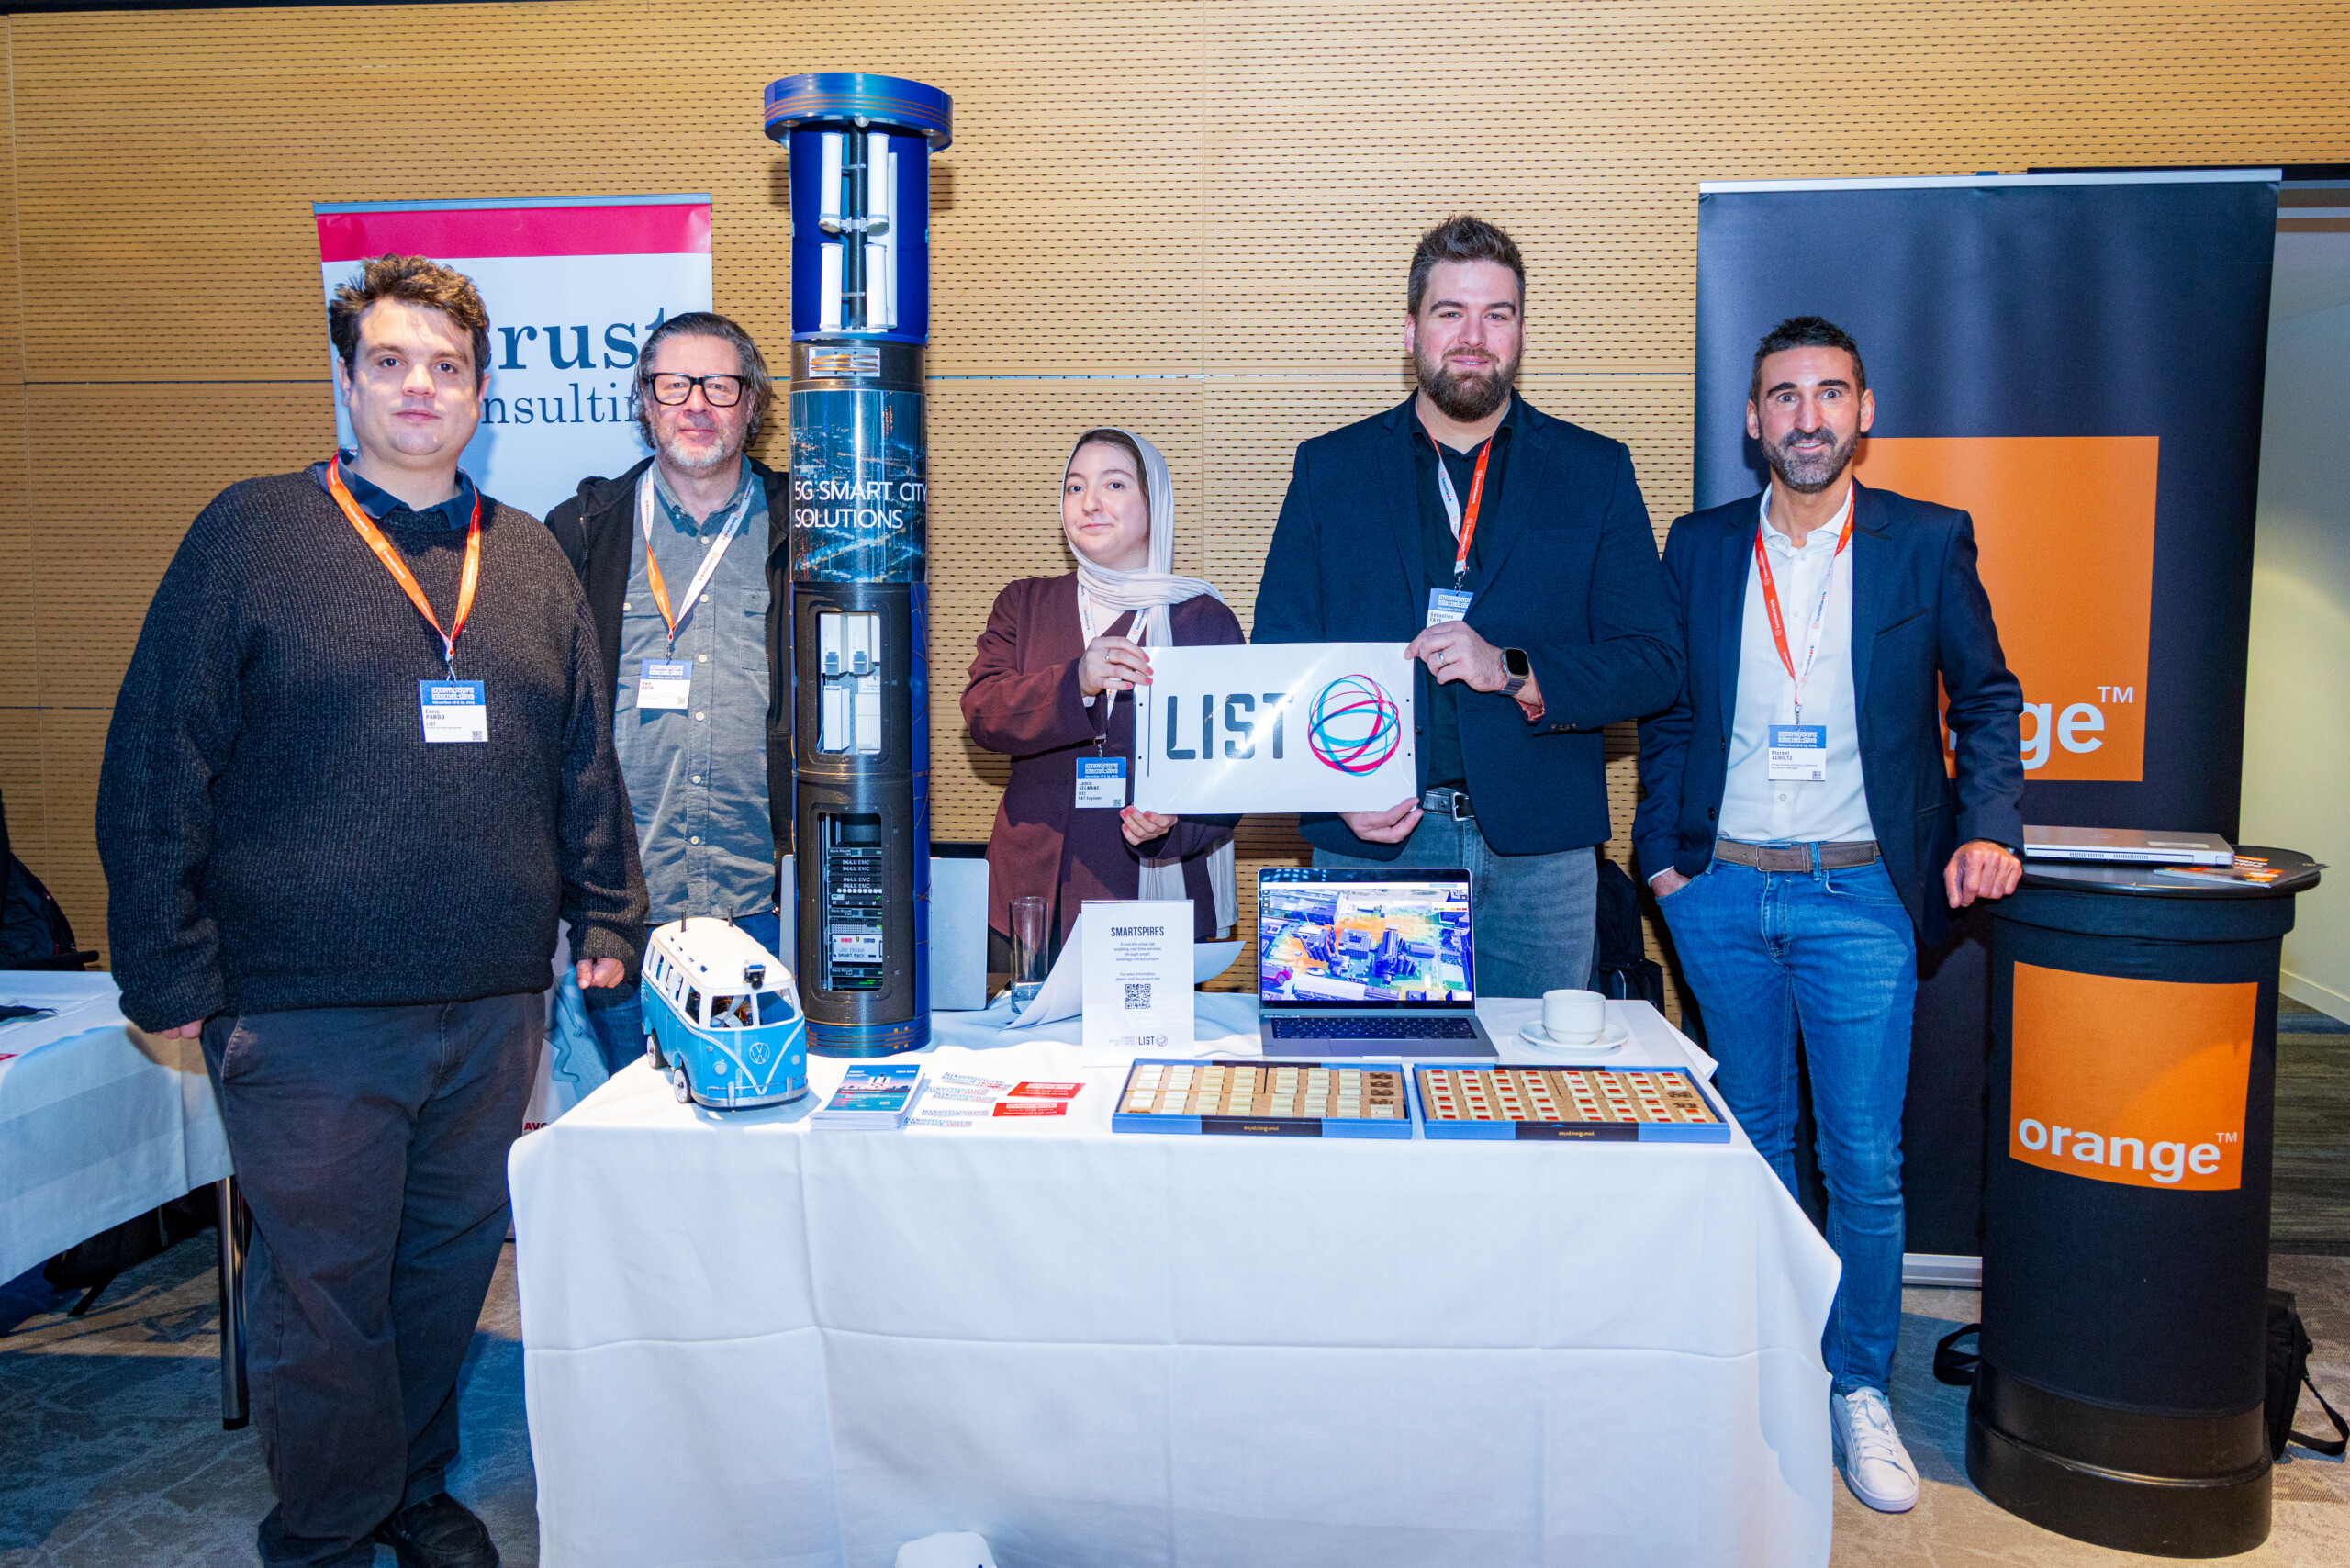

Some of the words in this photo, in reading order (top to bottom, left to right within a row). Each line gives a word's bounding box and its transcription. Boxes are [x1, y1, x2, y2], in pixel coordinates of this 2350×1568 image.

[484, 308, 665, 369] rus
[481, 382, 637, 424] nsulti
[794, 480, 813, 501] 5G
[818, 480, 893, 501] SMART
[899, 482, 928, 502] CITY
[795, 508, 904, 529] SOLUTIONS
[1166, 693, 1293, 760] LIST
[1111, 926, 1164, 937] SMARTSPIRES
[1139, 1036, 1154, 1045] LIST
[2019, 1118, 2221, 1183] orange
